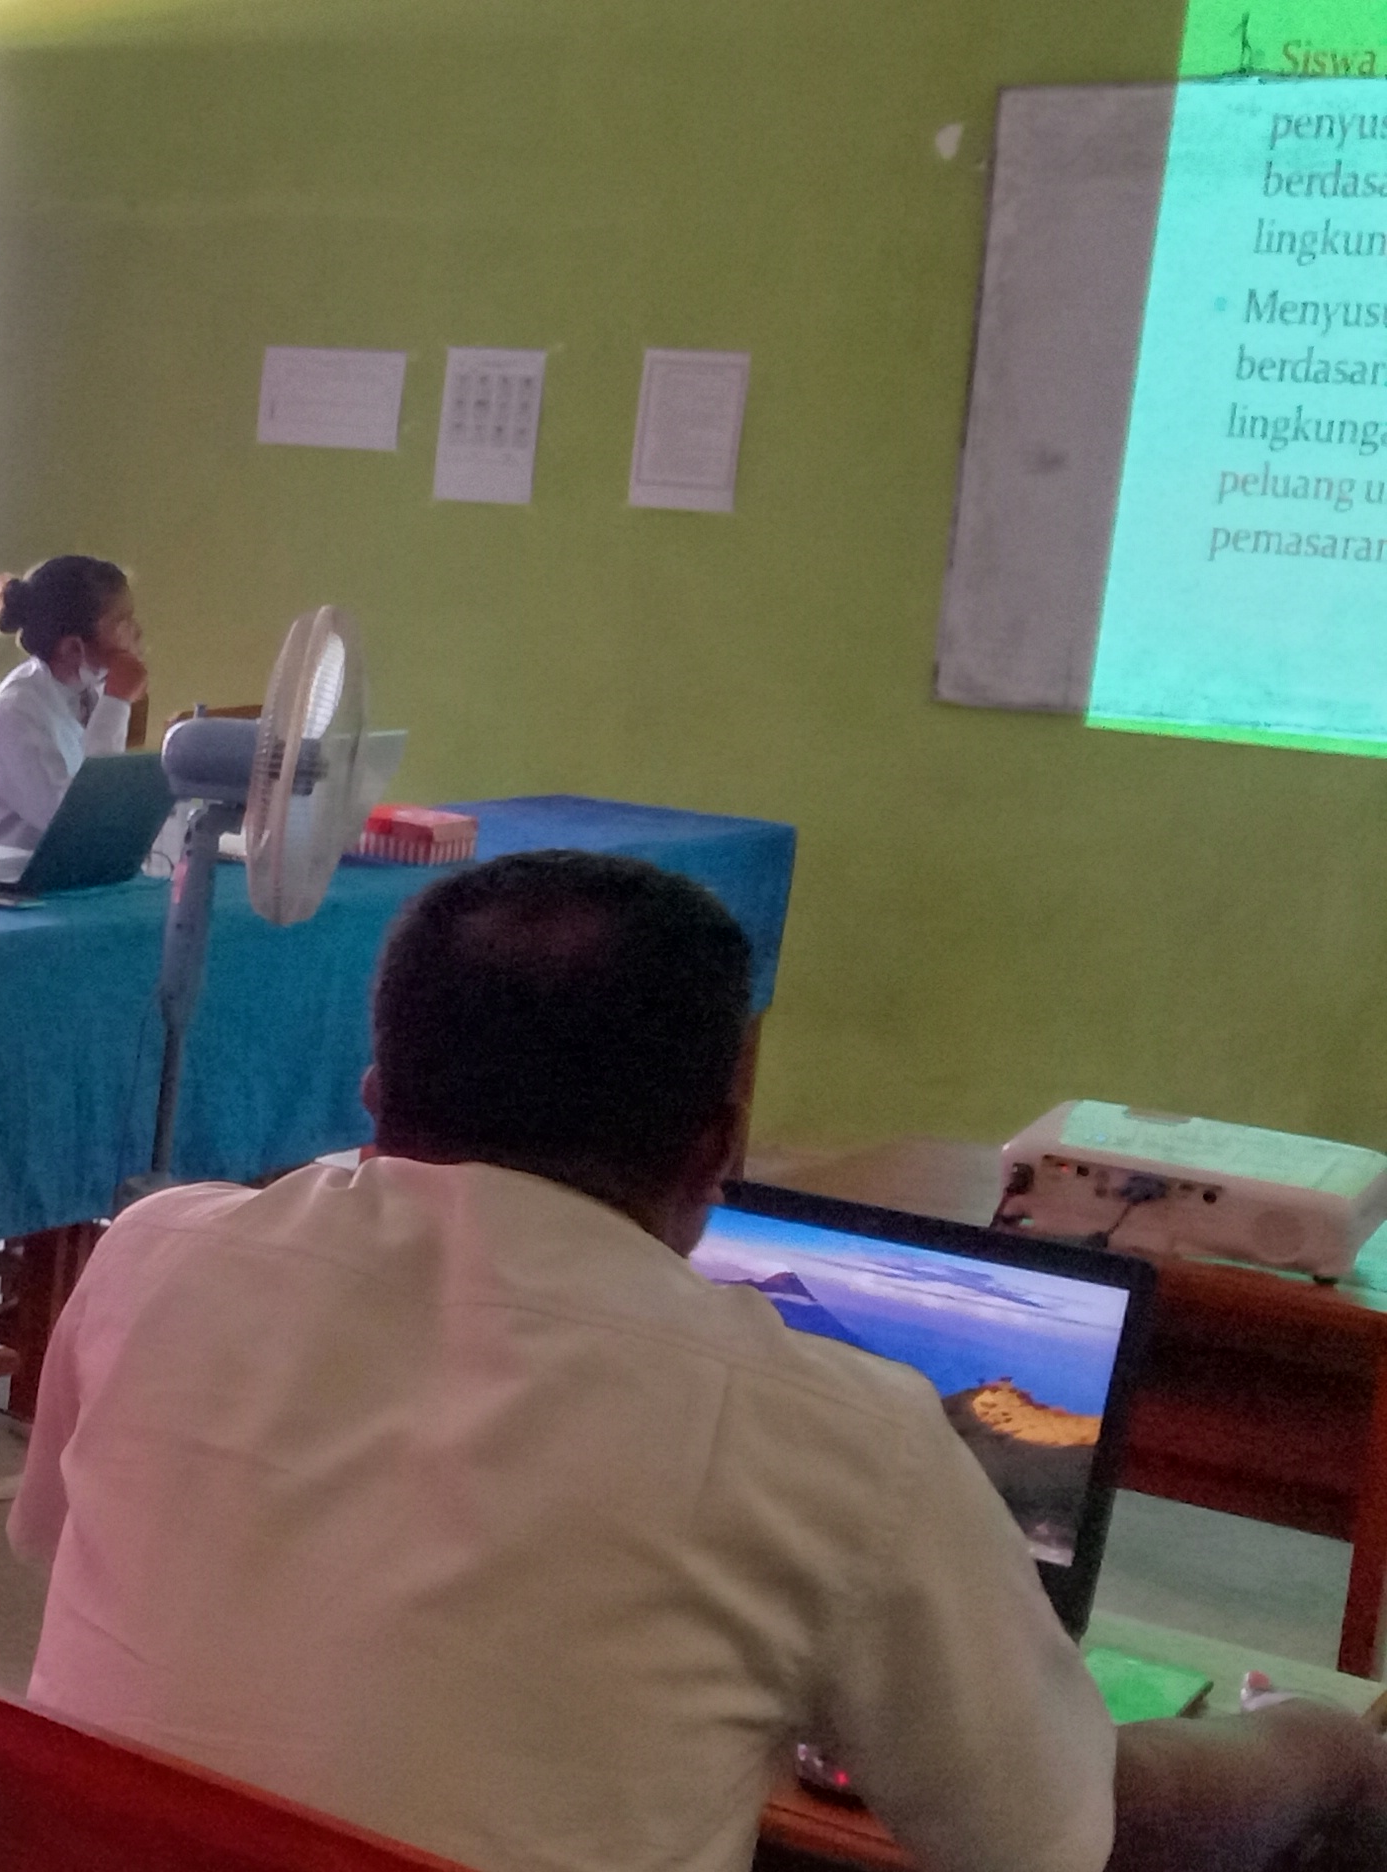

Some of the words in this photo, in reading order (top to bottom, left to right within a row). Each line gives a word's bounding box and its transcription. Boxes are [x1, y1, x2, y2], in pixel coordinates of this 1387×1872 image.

[1282, 39, 1376, 76] Siswa
[1243, 288, 1387, 337] Menyus
[1217, 460, 1356, 512] peluang
